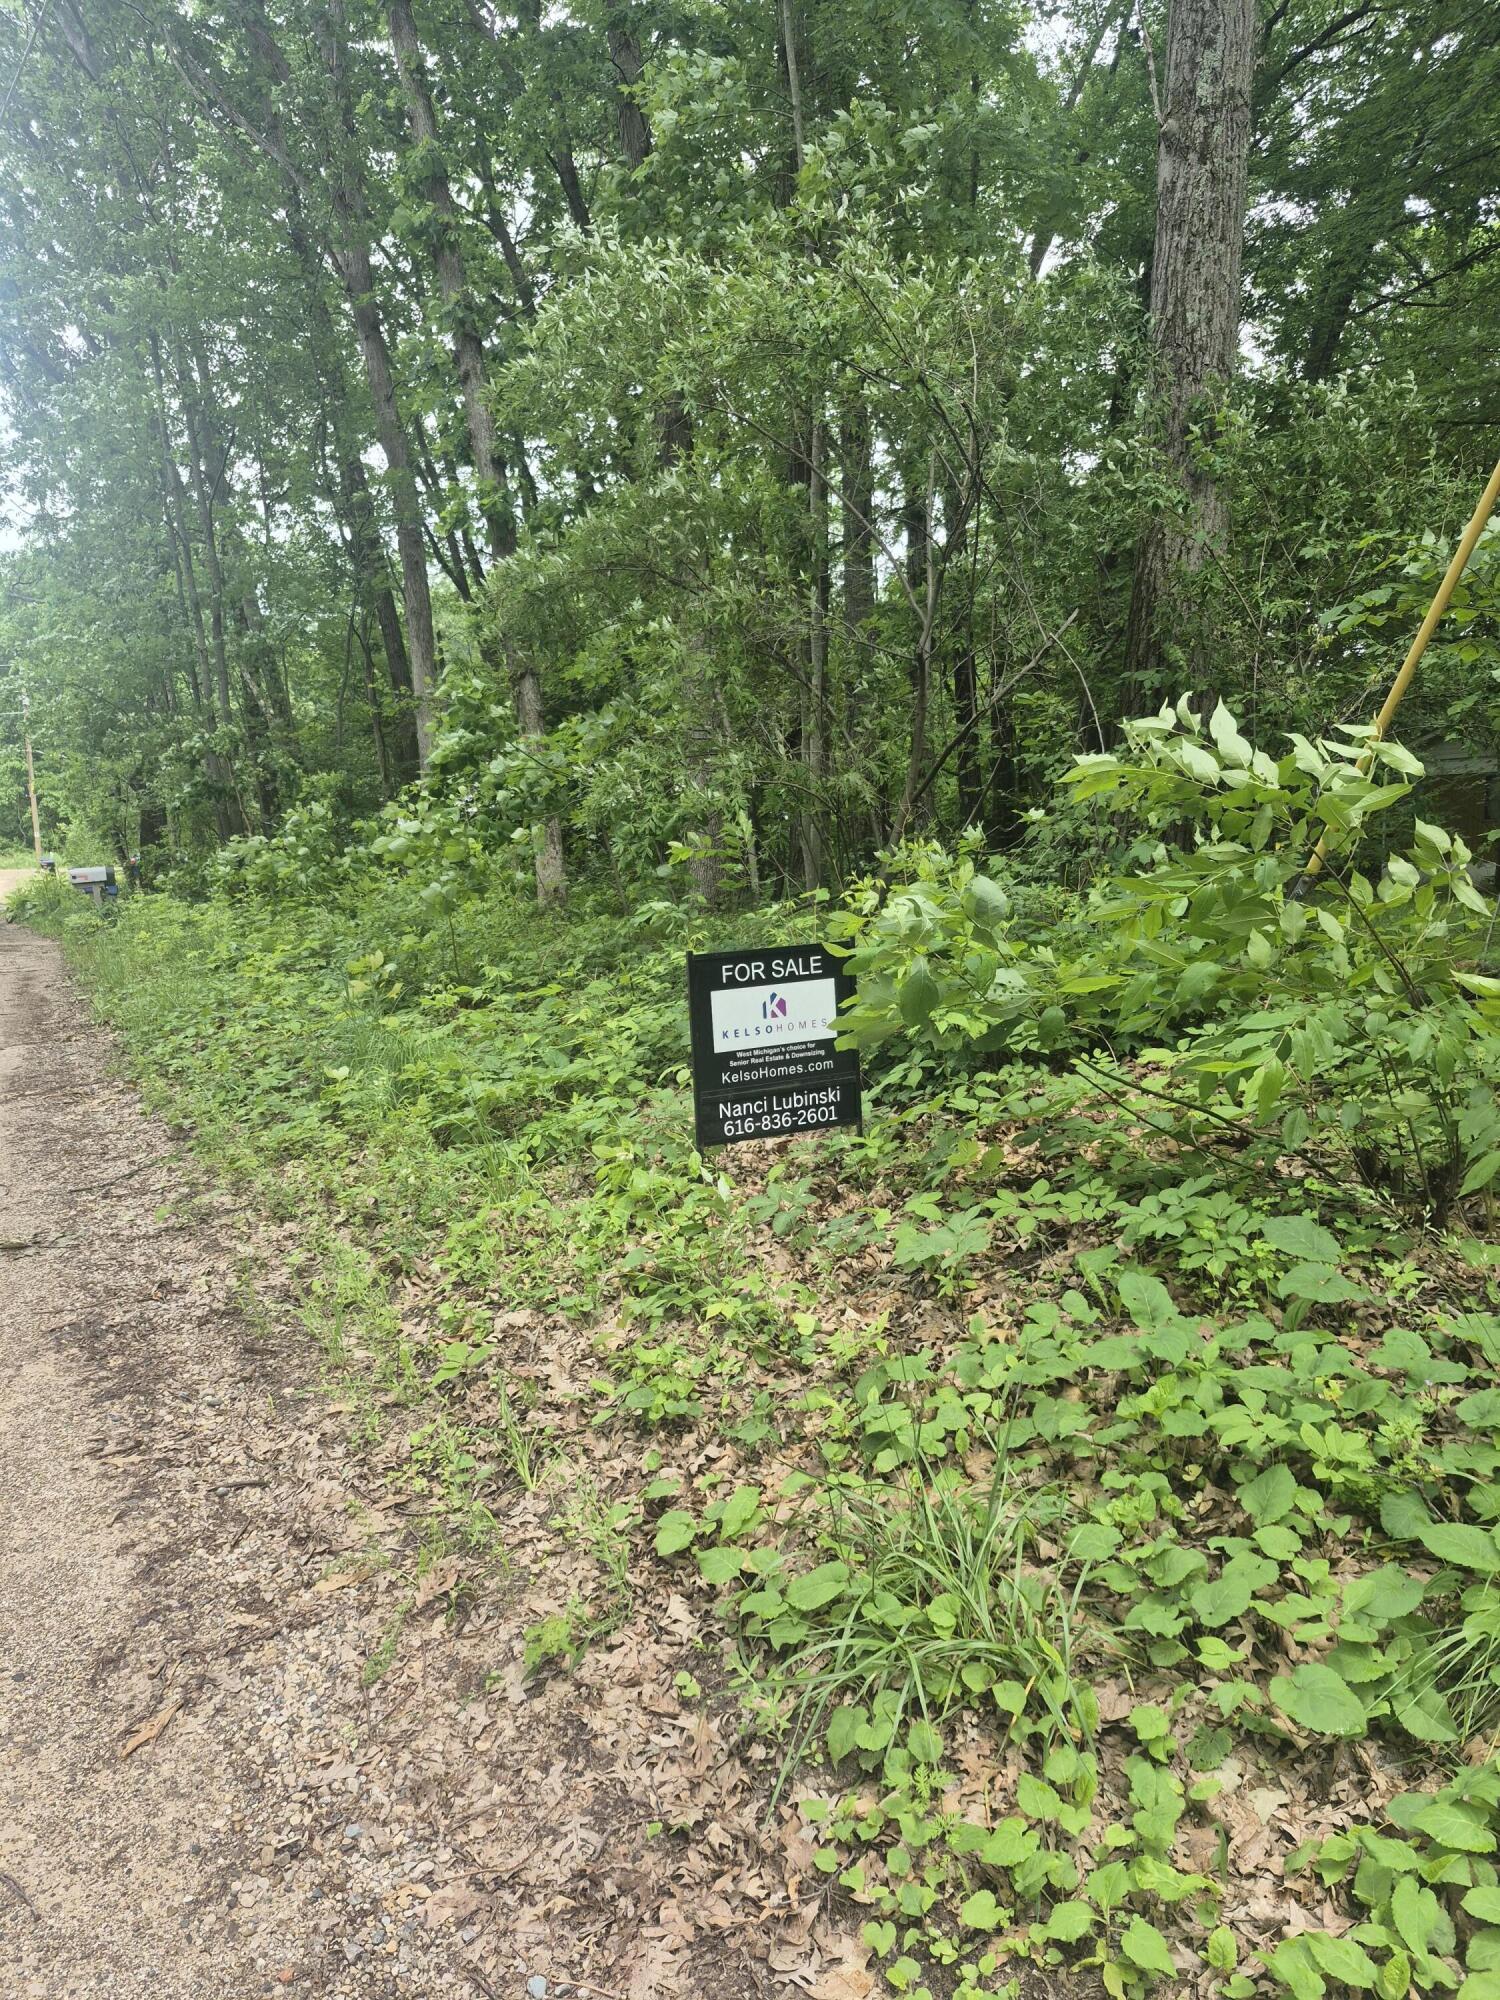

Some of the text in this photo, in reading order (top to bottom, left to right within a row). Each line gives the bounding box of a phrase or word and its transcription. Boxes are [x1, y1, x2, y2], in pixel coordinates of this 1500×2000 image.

[722, 955, 823, 984] FOR SALE
[729, 1059, 749, 1067] Senior
[750, 1056, 764, 1064] Real
[765, 1054, 784, 1063] Estate
[791, 1049, 825, 1060] Downsizing
[736, 1050, 752, 1058] West
[753, 1045, 786, 1056] Michigan's
[786, 1043, 806, 1052] choice
[722, 1060, 834, 1084] KelsoHomes.com
[719, 1086, 841, 1119] Nanci Lubinski
[723, 1106, 838, 1136] 616-836-2601
